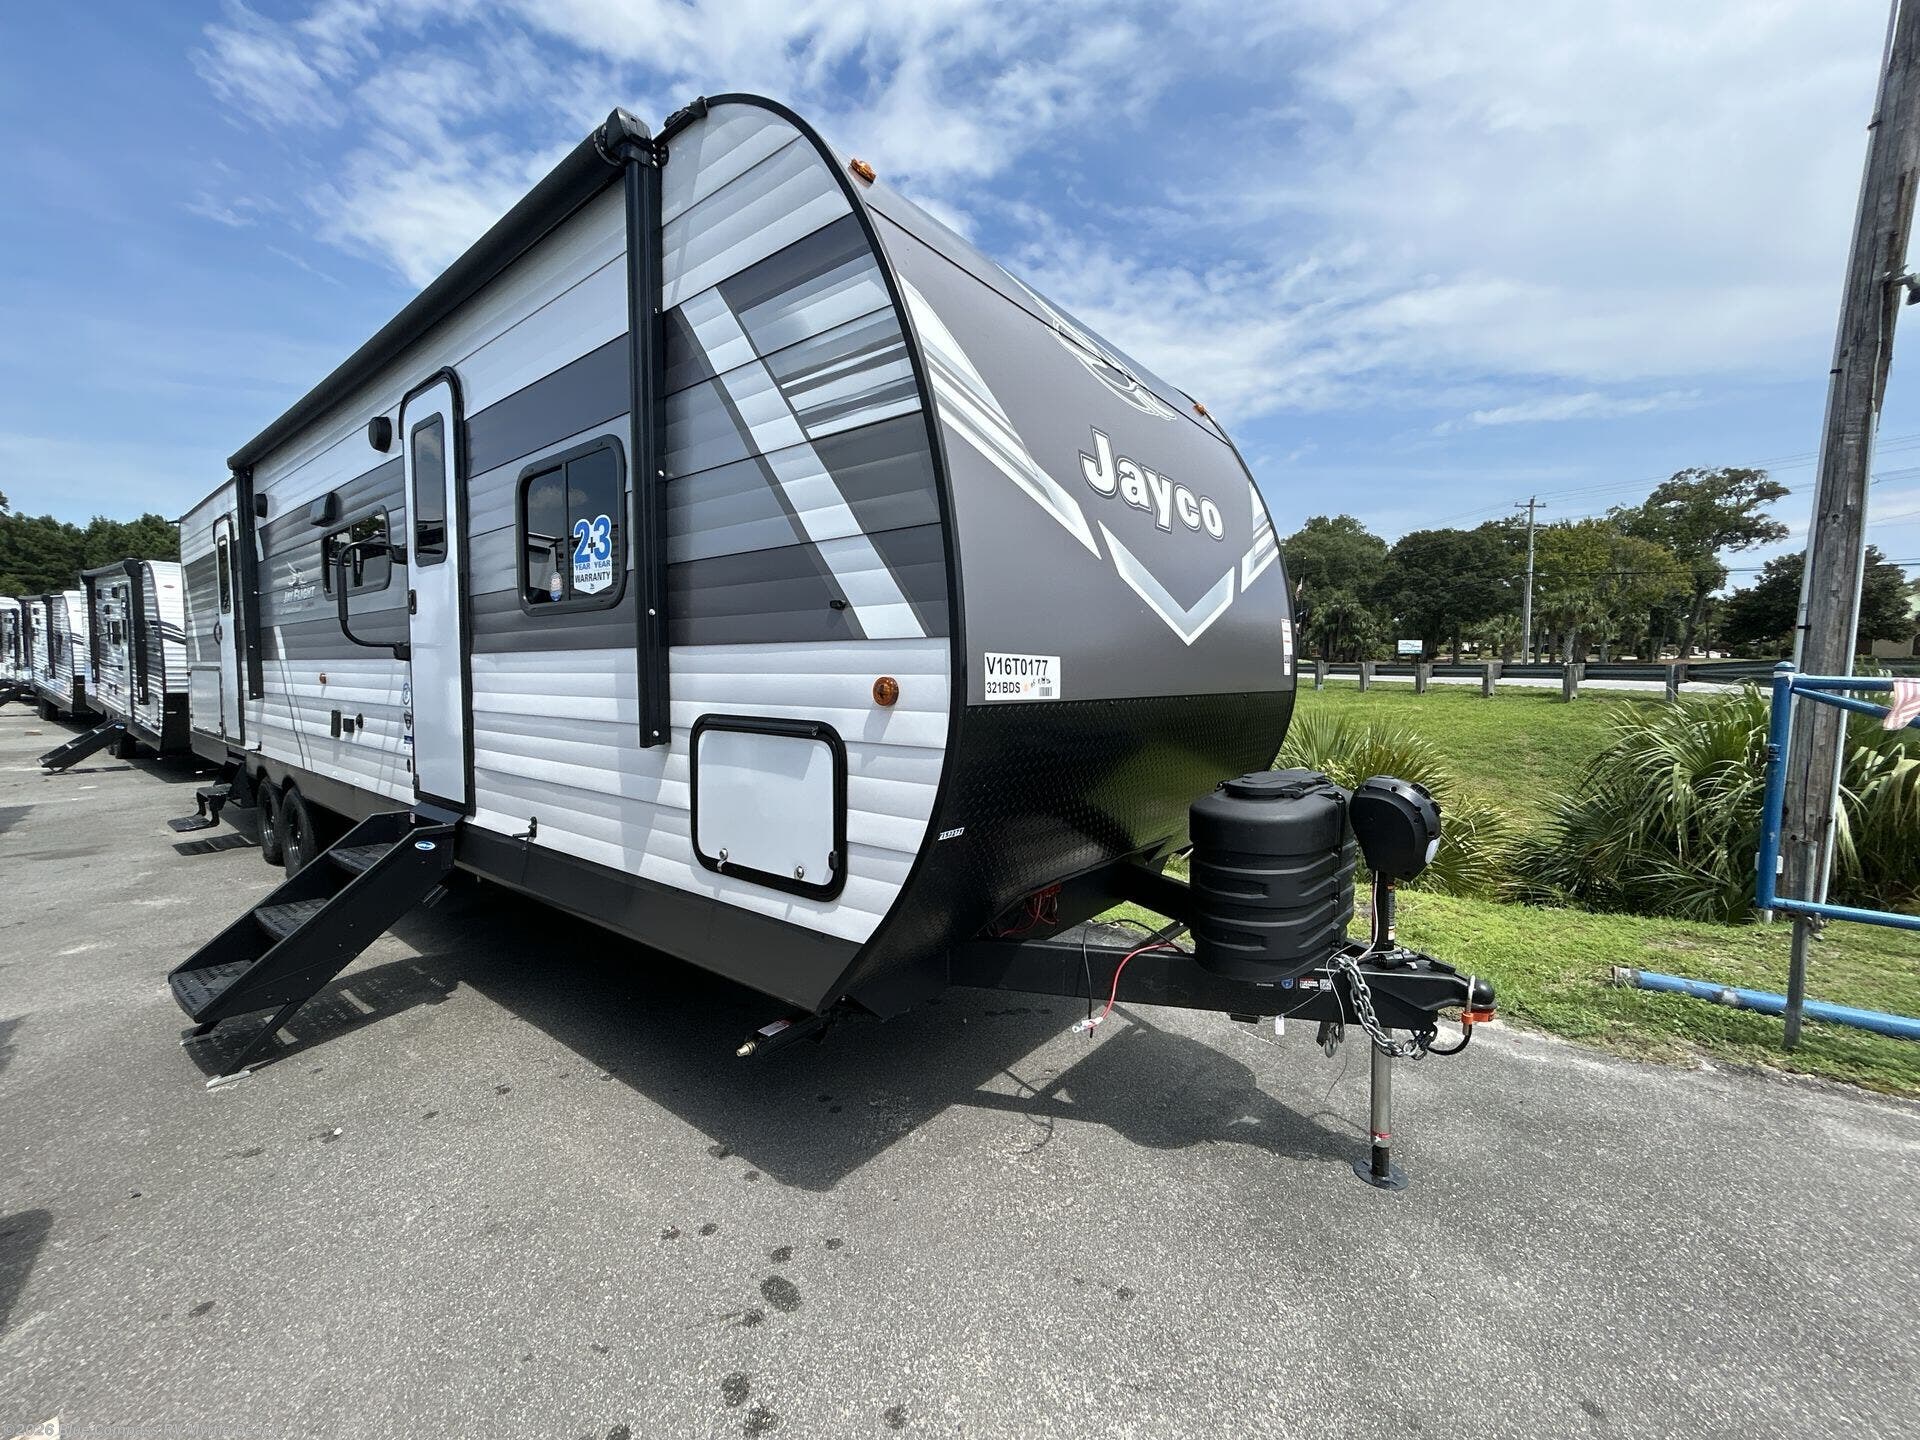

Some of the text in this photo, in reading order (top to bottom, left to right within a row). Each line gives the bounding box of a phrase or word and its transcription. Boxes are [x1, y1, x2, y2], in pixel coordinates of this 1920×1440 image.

[1079, 426, 1225, 542] Jayco
[575, 559, 611, 571] YEAR YEAR
[575, 571, 611, 583] WARRANTY
[986, 656, 1048, 676] V16T0177
[986, 681, 1021, 694] 321BDS
